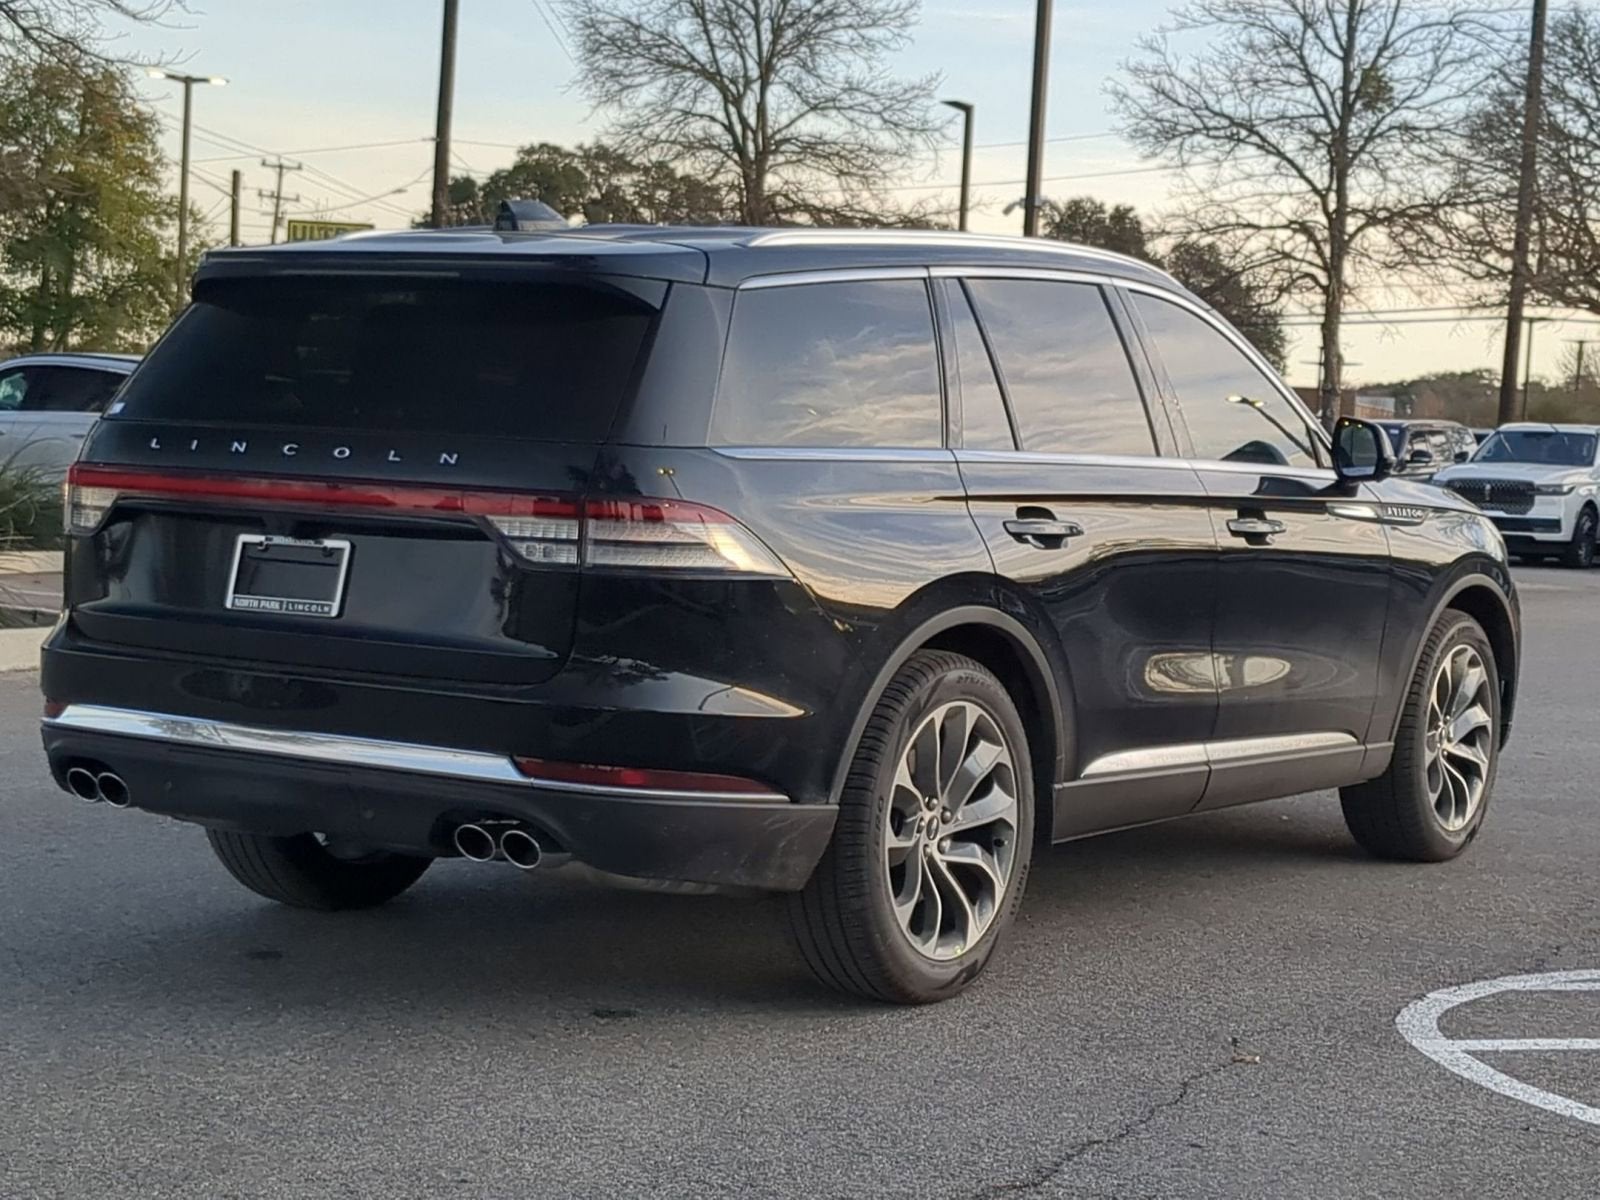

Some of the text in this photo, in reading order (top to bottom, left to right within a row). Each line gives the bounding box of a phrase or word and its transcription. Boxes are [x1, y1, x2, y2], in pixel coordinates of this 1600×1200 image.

[150, 437, 458, 465] LINCOLN
[234, 598, 332, 613] NORTH PARK LINCOLN
